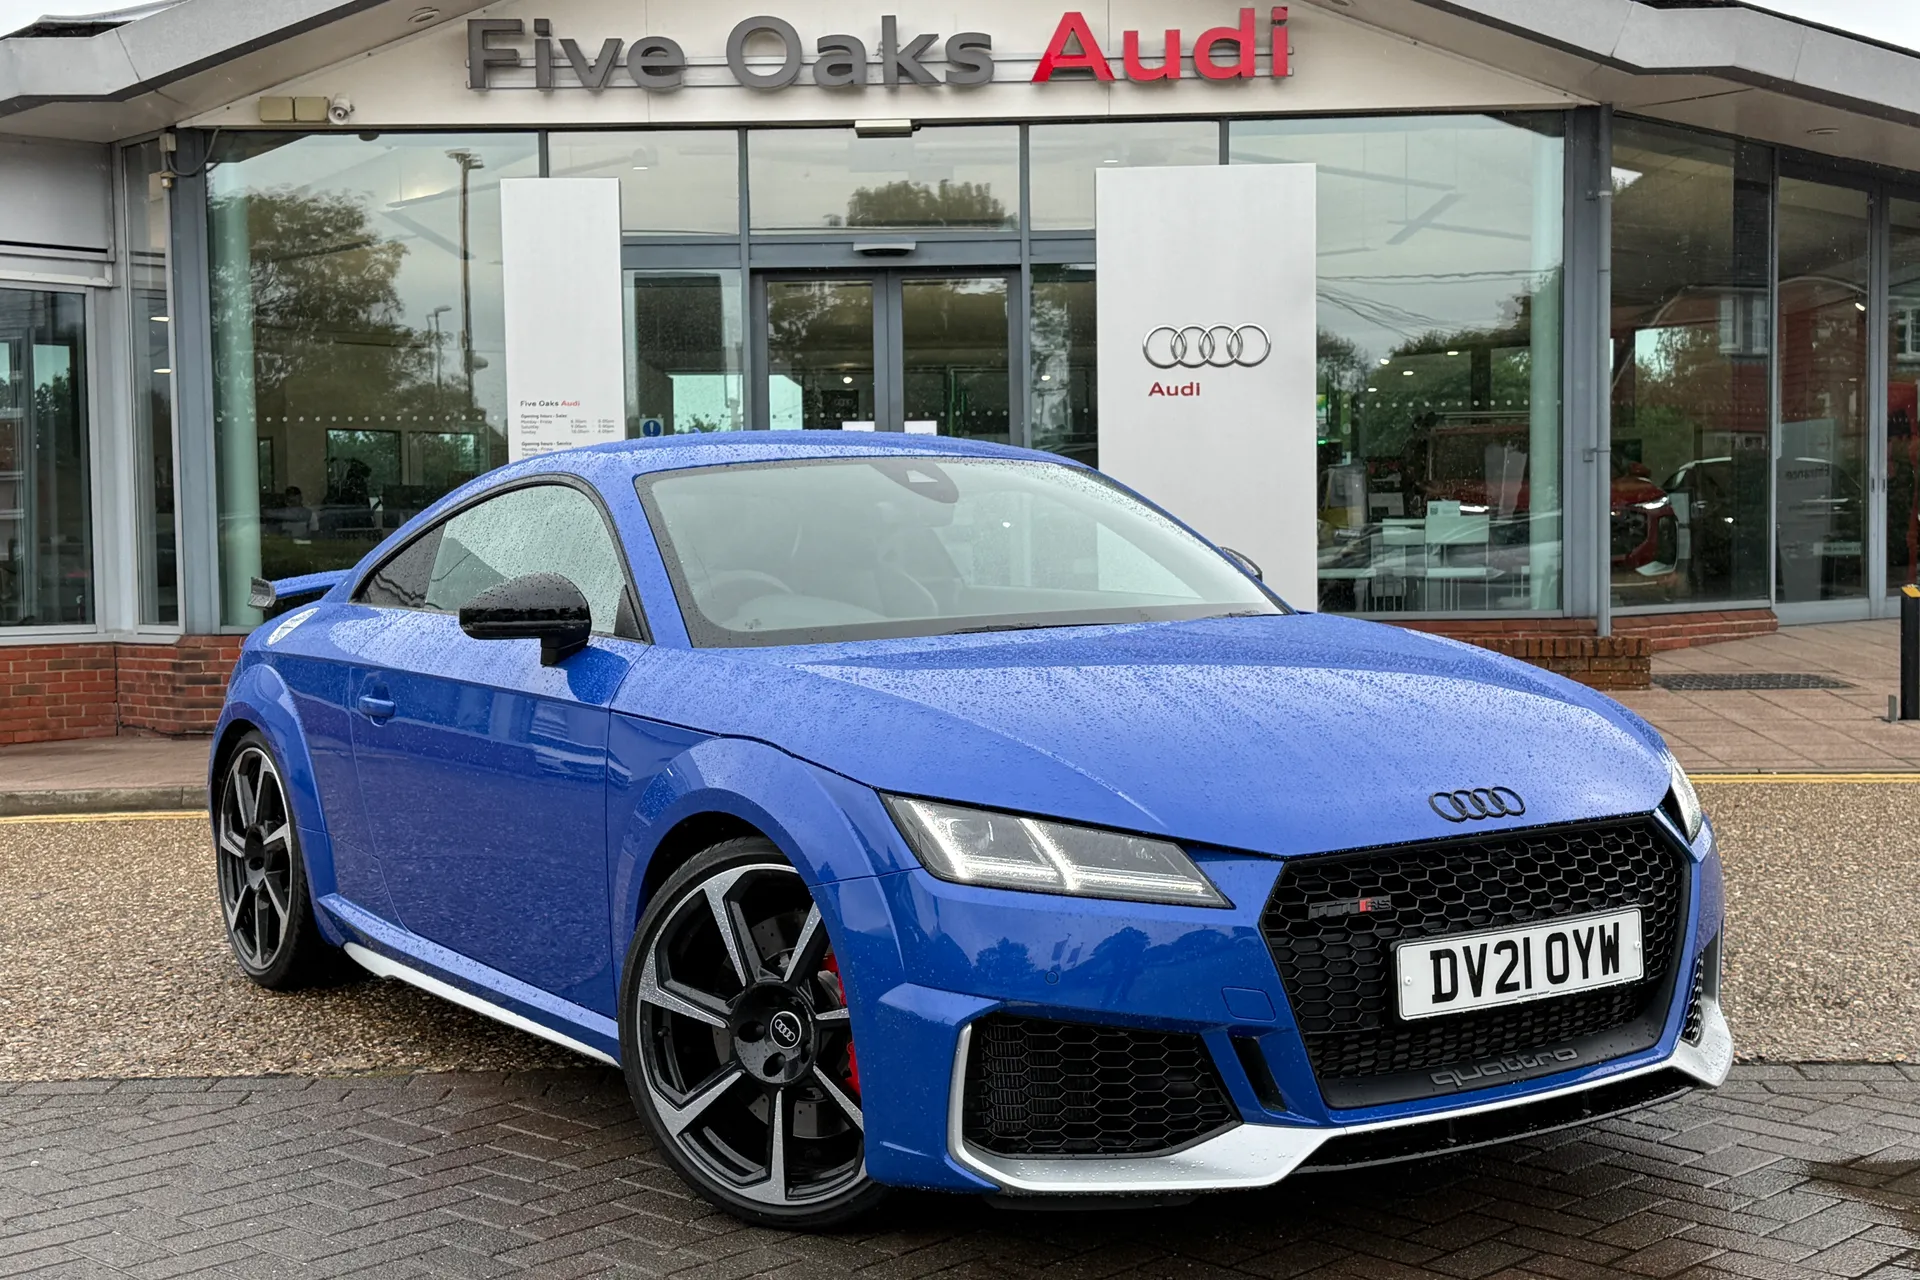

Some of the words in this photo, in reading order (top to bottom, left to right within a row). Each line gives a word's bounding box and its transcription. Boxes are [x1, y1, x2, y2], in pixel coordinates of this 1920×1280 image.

[467, 19, 686, 92] Five
[726, 15, 995, 91] Oaks
[1031, 6, 1289, 83] Audi
[1148, 381, 1201, 397] Audi
[1430, 936, 1533, 1004] DV21
[1430, 1048, 1578, 1087] quattro
